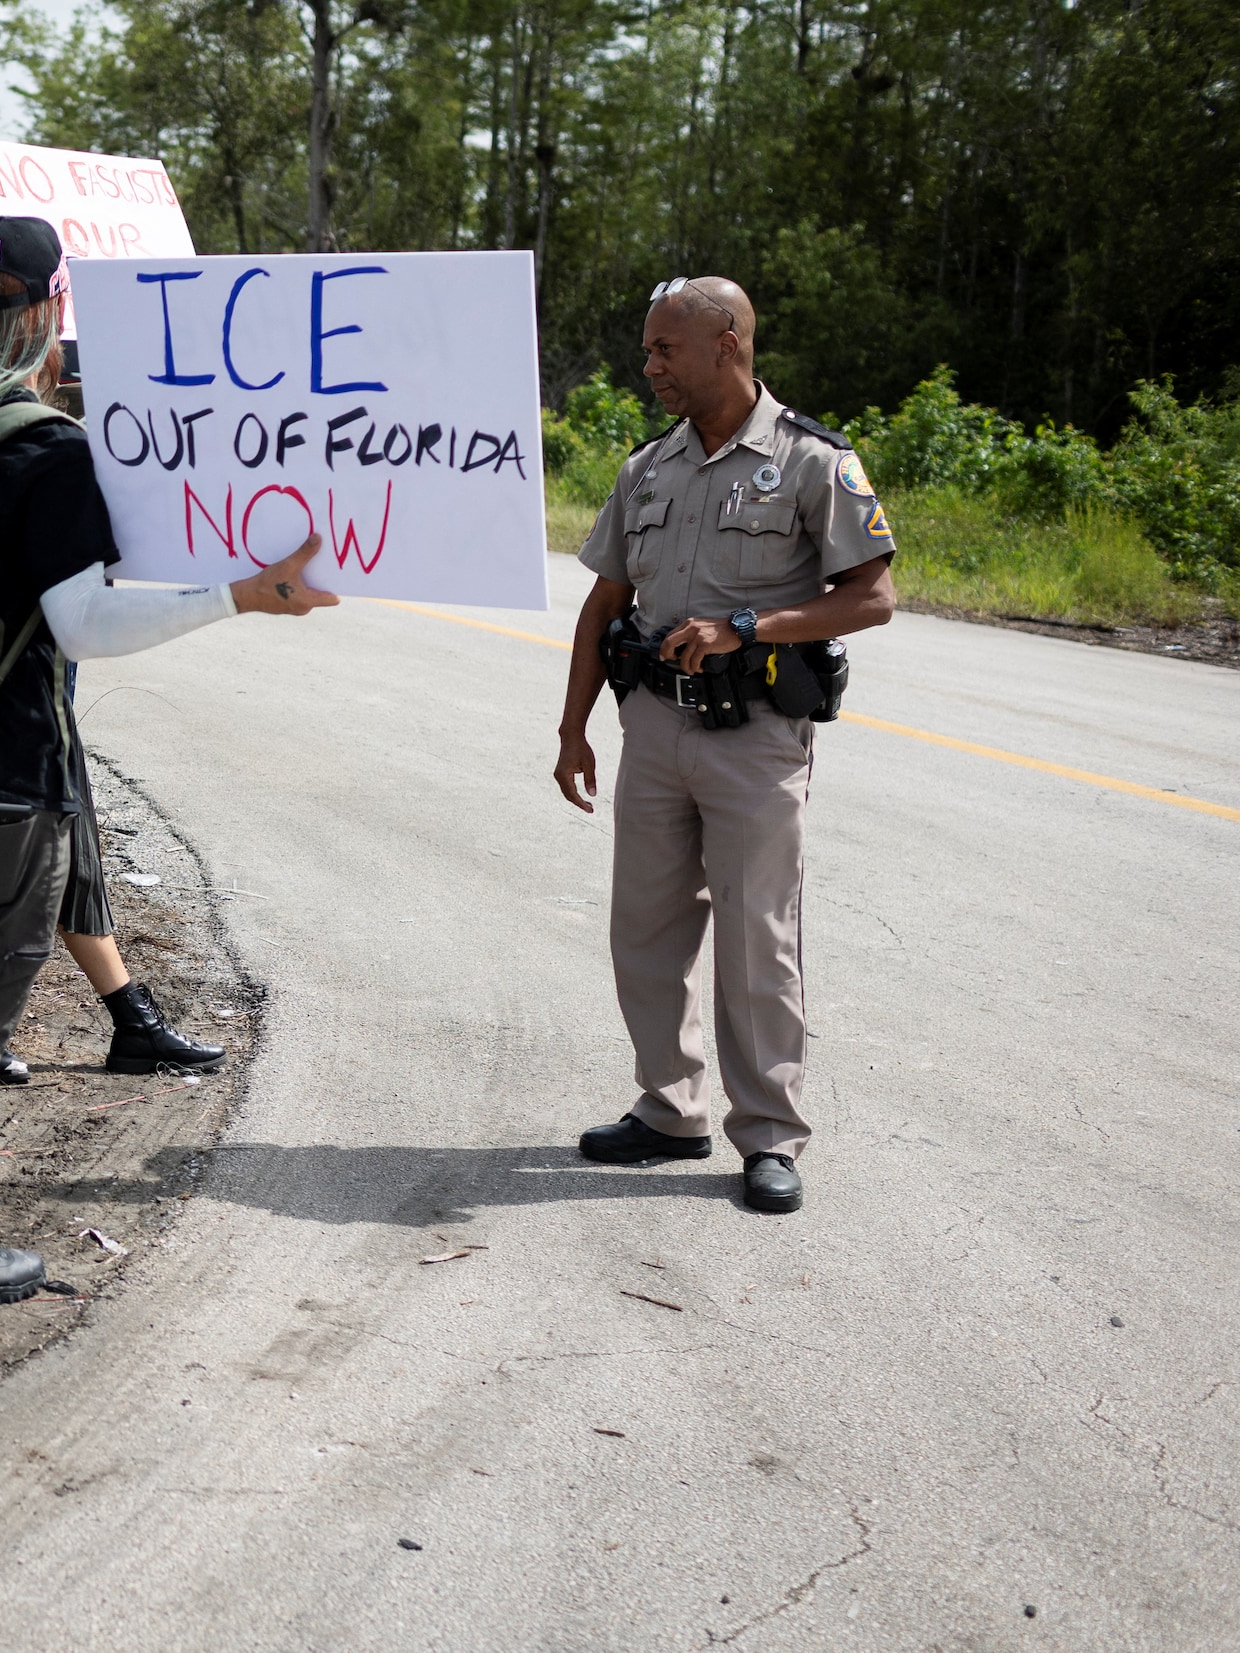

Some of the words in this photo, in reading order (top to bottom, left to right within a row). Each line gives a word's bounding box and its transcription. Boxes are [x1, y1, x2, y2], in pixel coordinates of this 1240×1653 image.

[68, 161, 177, 207] FASCISTS
[62, 218, 154, 258] OUR
[137, 266, 390, 394] ICE
[103, 401, 215, 470] OUT
[234, 411, 309, 468] OF
[326, 406, 527, 480] FLORIDA
[184, 478, 392, 575] NOW
